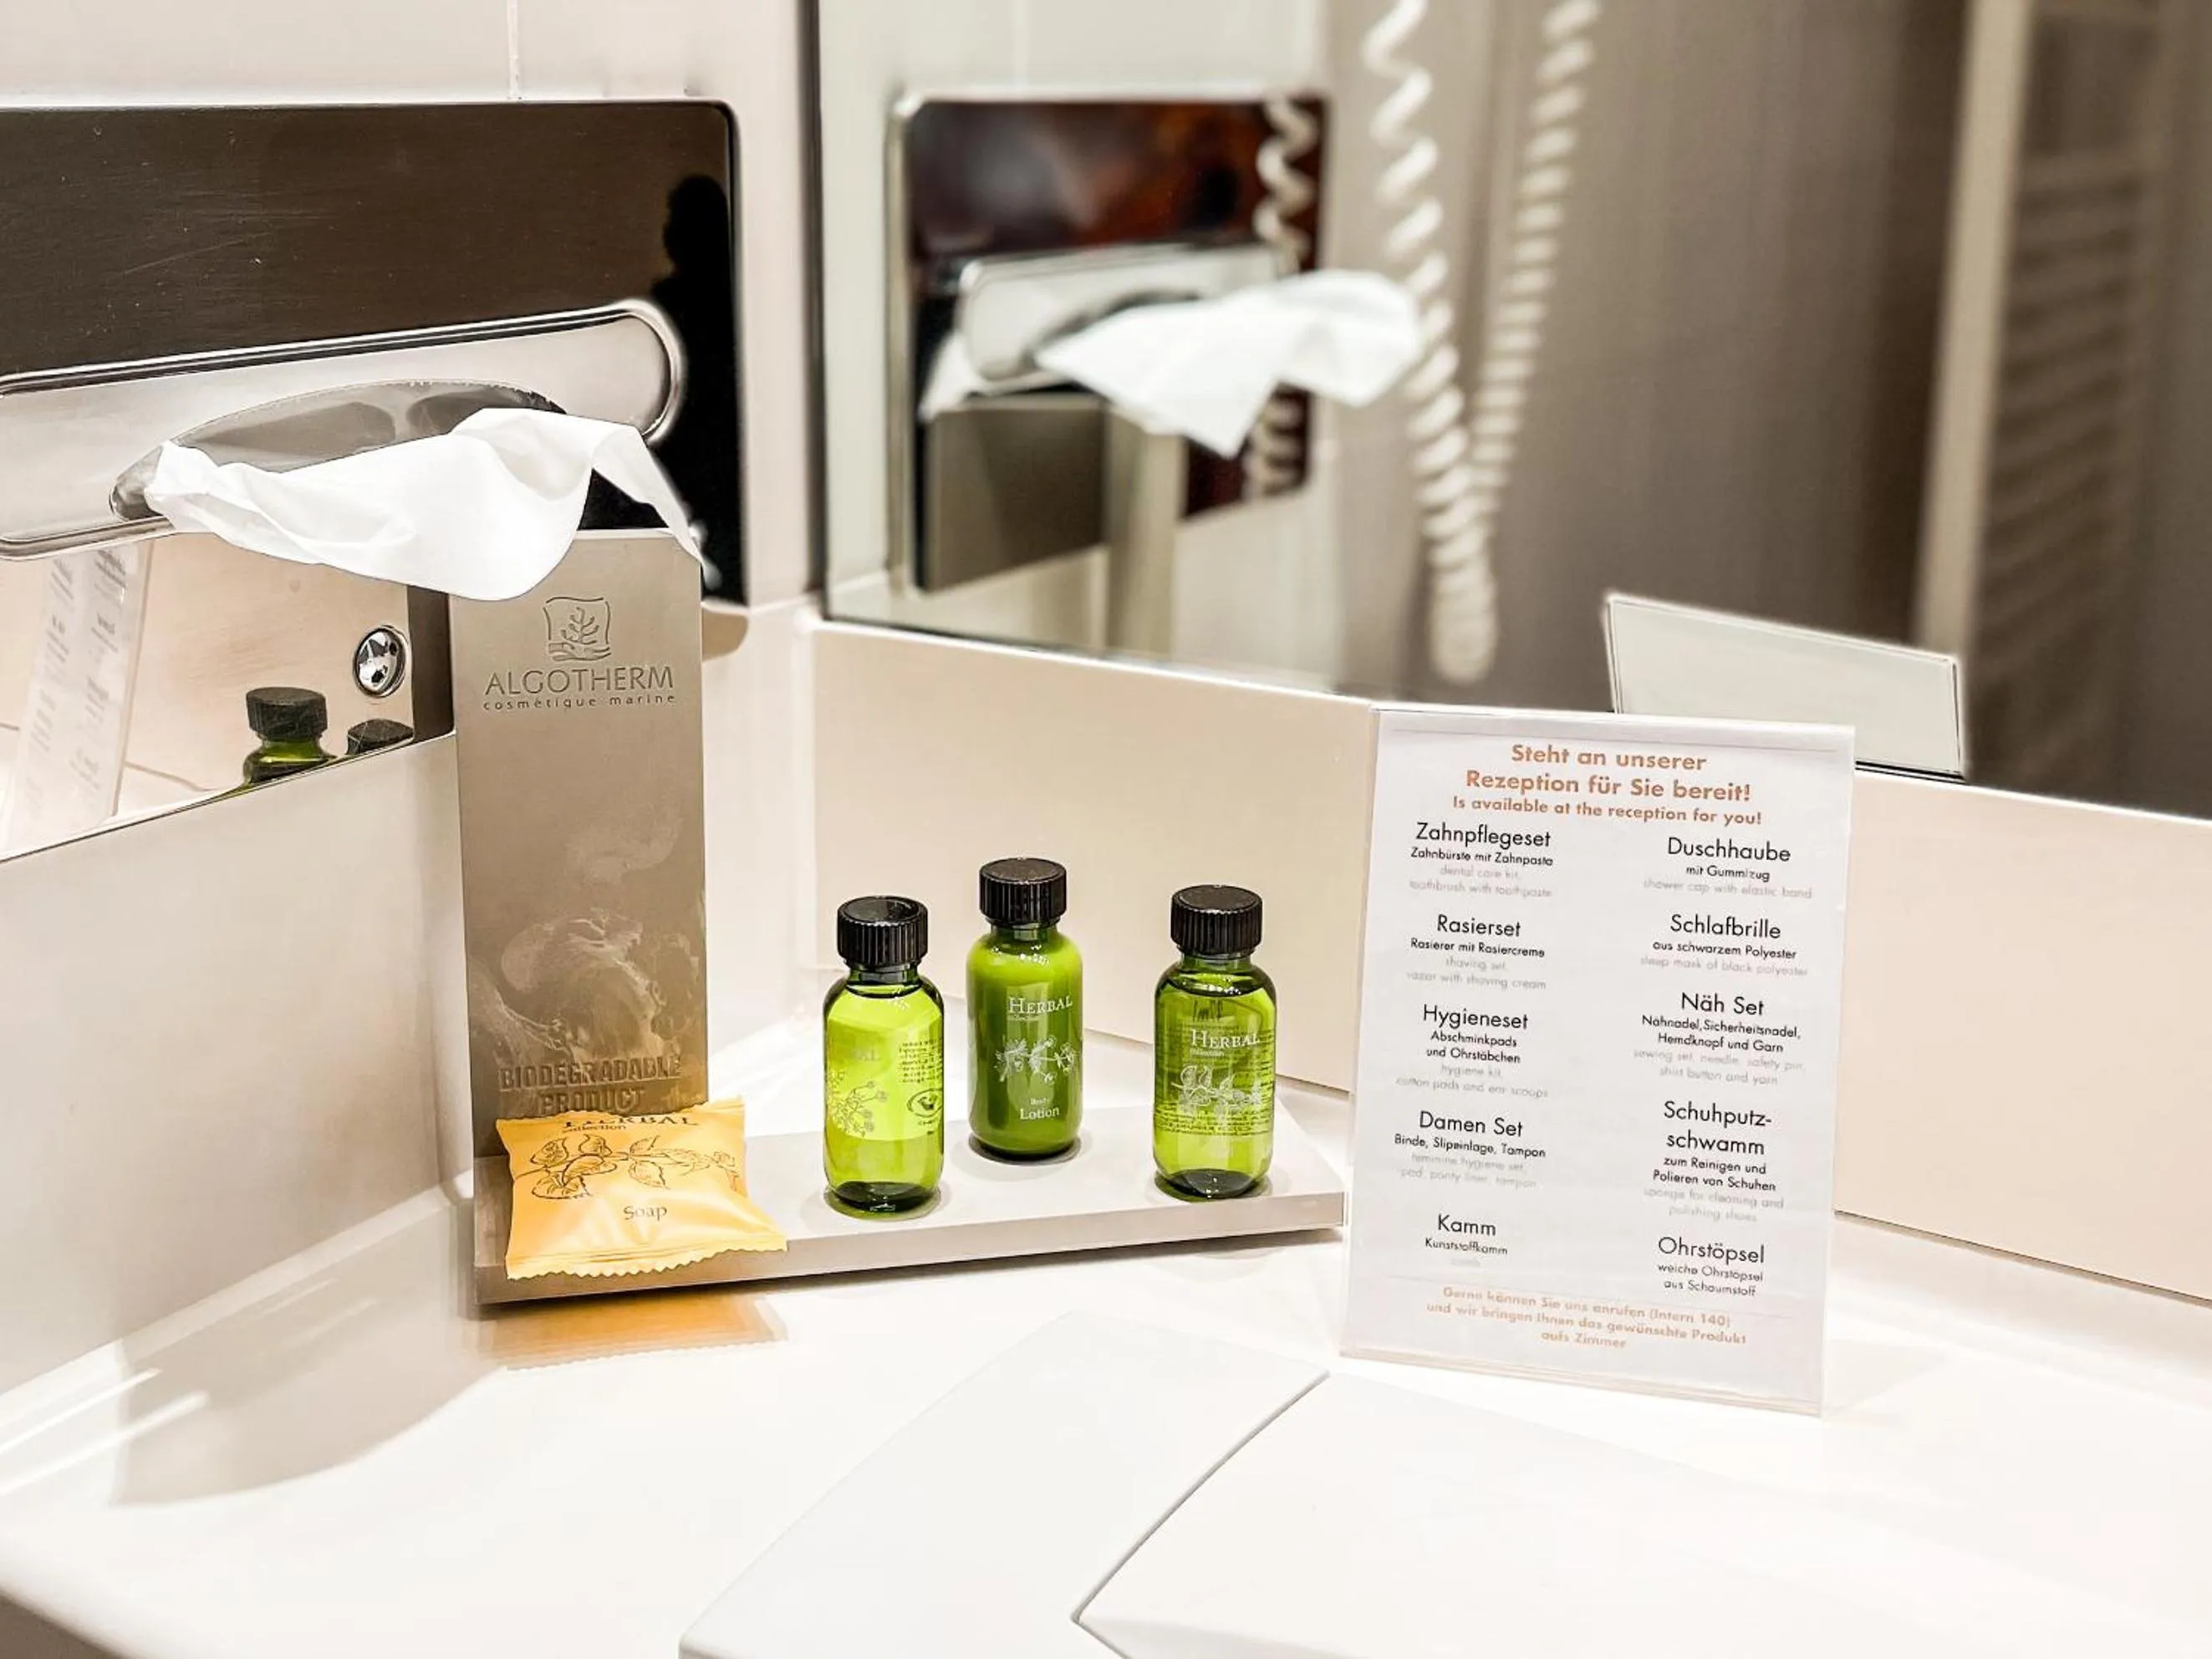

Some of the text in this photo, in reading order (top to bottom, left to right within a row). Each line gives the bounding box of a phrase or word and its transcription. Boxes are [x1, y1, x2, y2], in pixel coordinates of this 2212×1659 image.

[485, 666, 674, 695] ALGOTHERM
[609, 694, 675, 707] marine
[1511, 744, 1707, 770] Steht an unserer
[1466, 770, 1751, 802] Rezeption für Sie bereit!
[1454, 796, 1762, 827] Is available at the reception for you!
[1416, 822, 1551, 849] Zahnpflegeset
[1475, 852, 1491, 862] mit
[1495, 852, 1553, 866] Zahnpasta
[1668, 837, 1791, 862] Duschhaube
[1687, 865, 1770, 883] mit Gummizug
[1437, 913, 1521, 937] Rasierset
[1670, 913, 1781, 939] Schlafbrille
[1411, 938, 1545, 958] Rasierer mit Rasiercreme
[1653, 941, 1797, 961] aus schwarzem Polyester
[1681, 992, 1765, 1016] Näh Set
[1424, 1004, 1529, 1030] Hygieneset
[1430, 1031, 1517, 1047] Abschminkpads
[1658, 1032, 1784, 1053] Hemdknopf und Garn
[1426, 1047, 1521, 1064] und Ohrstäbchen
[501, 1056, 681, 1089] BIODEGRADABLE
[1020, 1107, 1060, 1120] Lotion
[1419, 1110, 1523, 1137] Damen Set
[1664, 1101, 1772, 1128] Schuhputz-
[1501, 1143, 1546, 1159] Tampon
[1666, 1129, 1765, 1155] schwamm
[1664, 1158, 1766, 1174] zum Reinigen und
[1654, 1169, 1776, 1191] Polieren von Schuhen
[623, 1205, 668, 1221] Soap
[1438, 1214, 1496, 1236] Kamm
[1659, 1237, 1765, 1265] Ohrstöpsel
[1657, 1264, 1698, 1275] weiche
[1664, 1281, 1684, 1290] aus
[1542, 1297, 1561, 1309] Sie
[1427, 1303, 1451, 1314] und
[1455, 1304, 1477, 1315] wir
[1481, 1306, 1533, 1323] bringen
[1578, 1317, 1603, 1330] das
